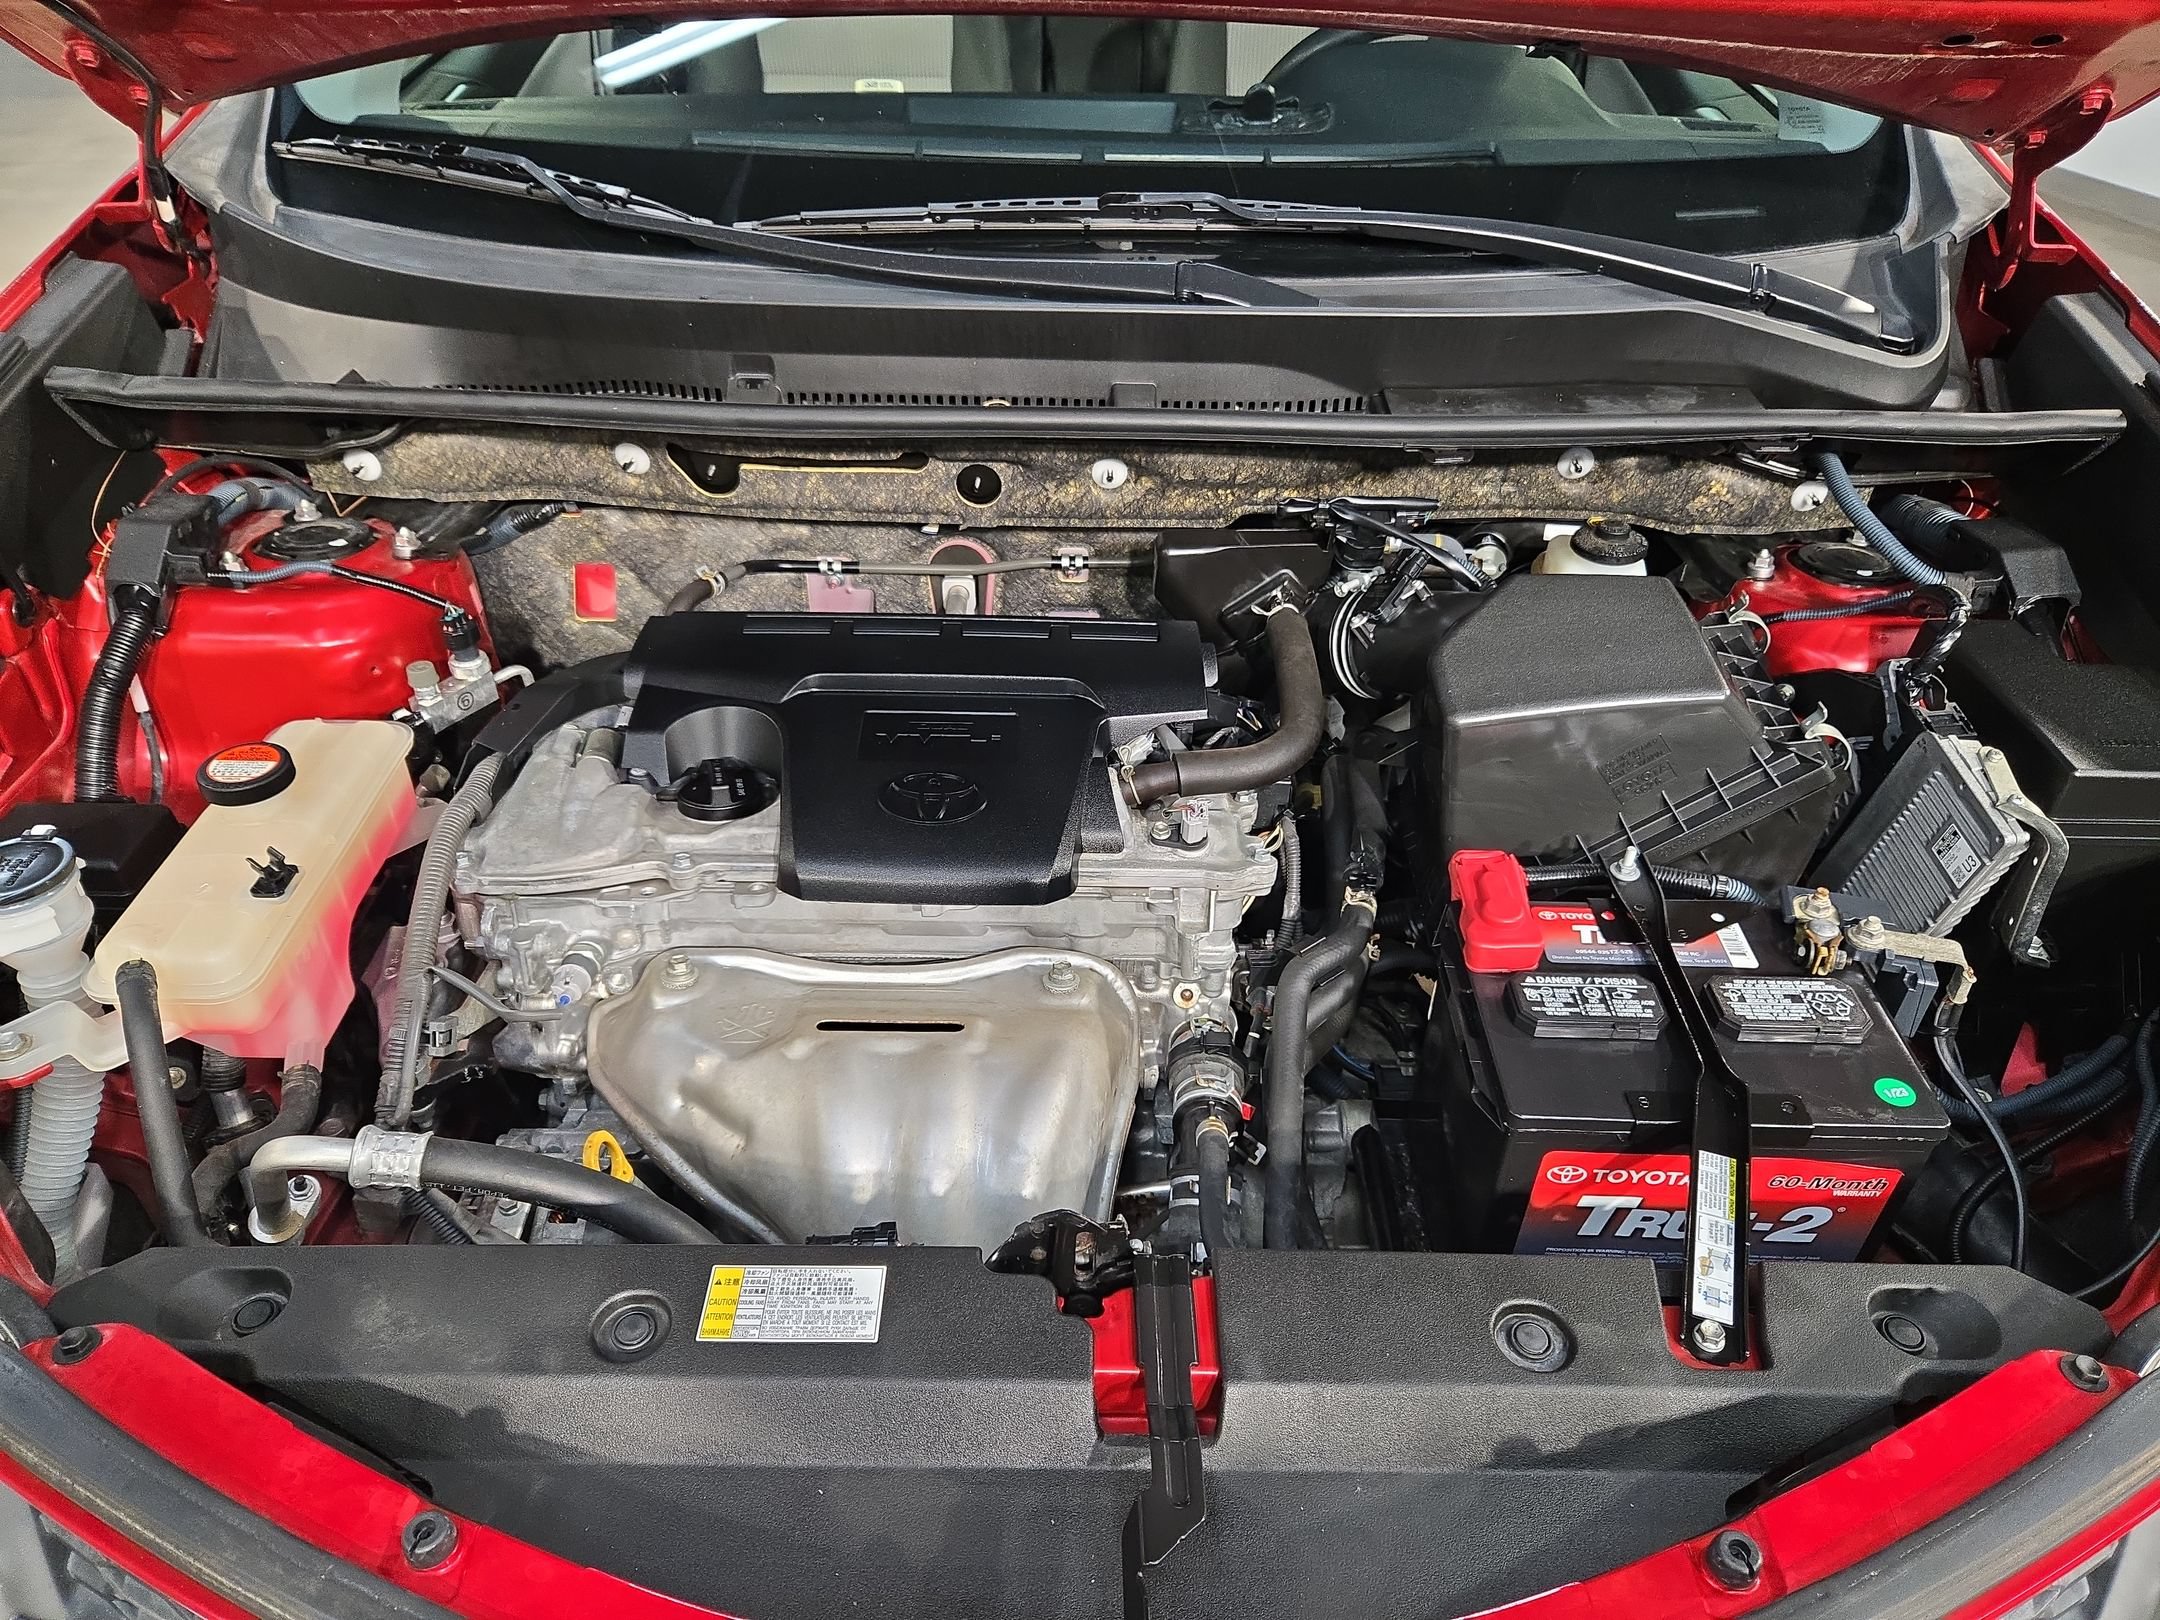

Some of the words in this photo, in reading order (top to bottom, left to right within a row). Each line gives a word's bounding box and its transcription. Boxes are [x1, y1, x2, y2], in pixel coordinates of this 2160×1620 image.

[1961, 855, 1977, 873] U3
[1536, 976, 1584, 984] DANGER
[1585, 976, 1591, 984] /
[1594, 977, 1637, 986] POISON
[1767, 1175, 1889, 1192] 60-Month
[1832, 1190, 1882, 1198] WARRANTY
[701, 1328, 730, 1336] ВНИМАНИЕ
